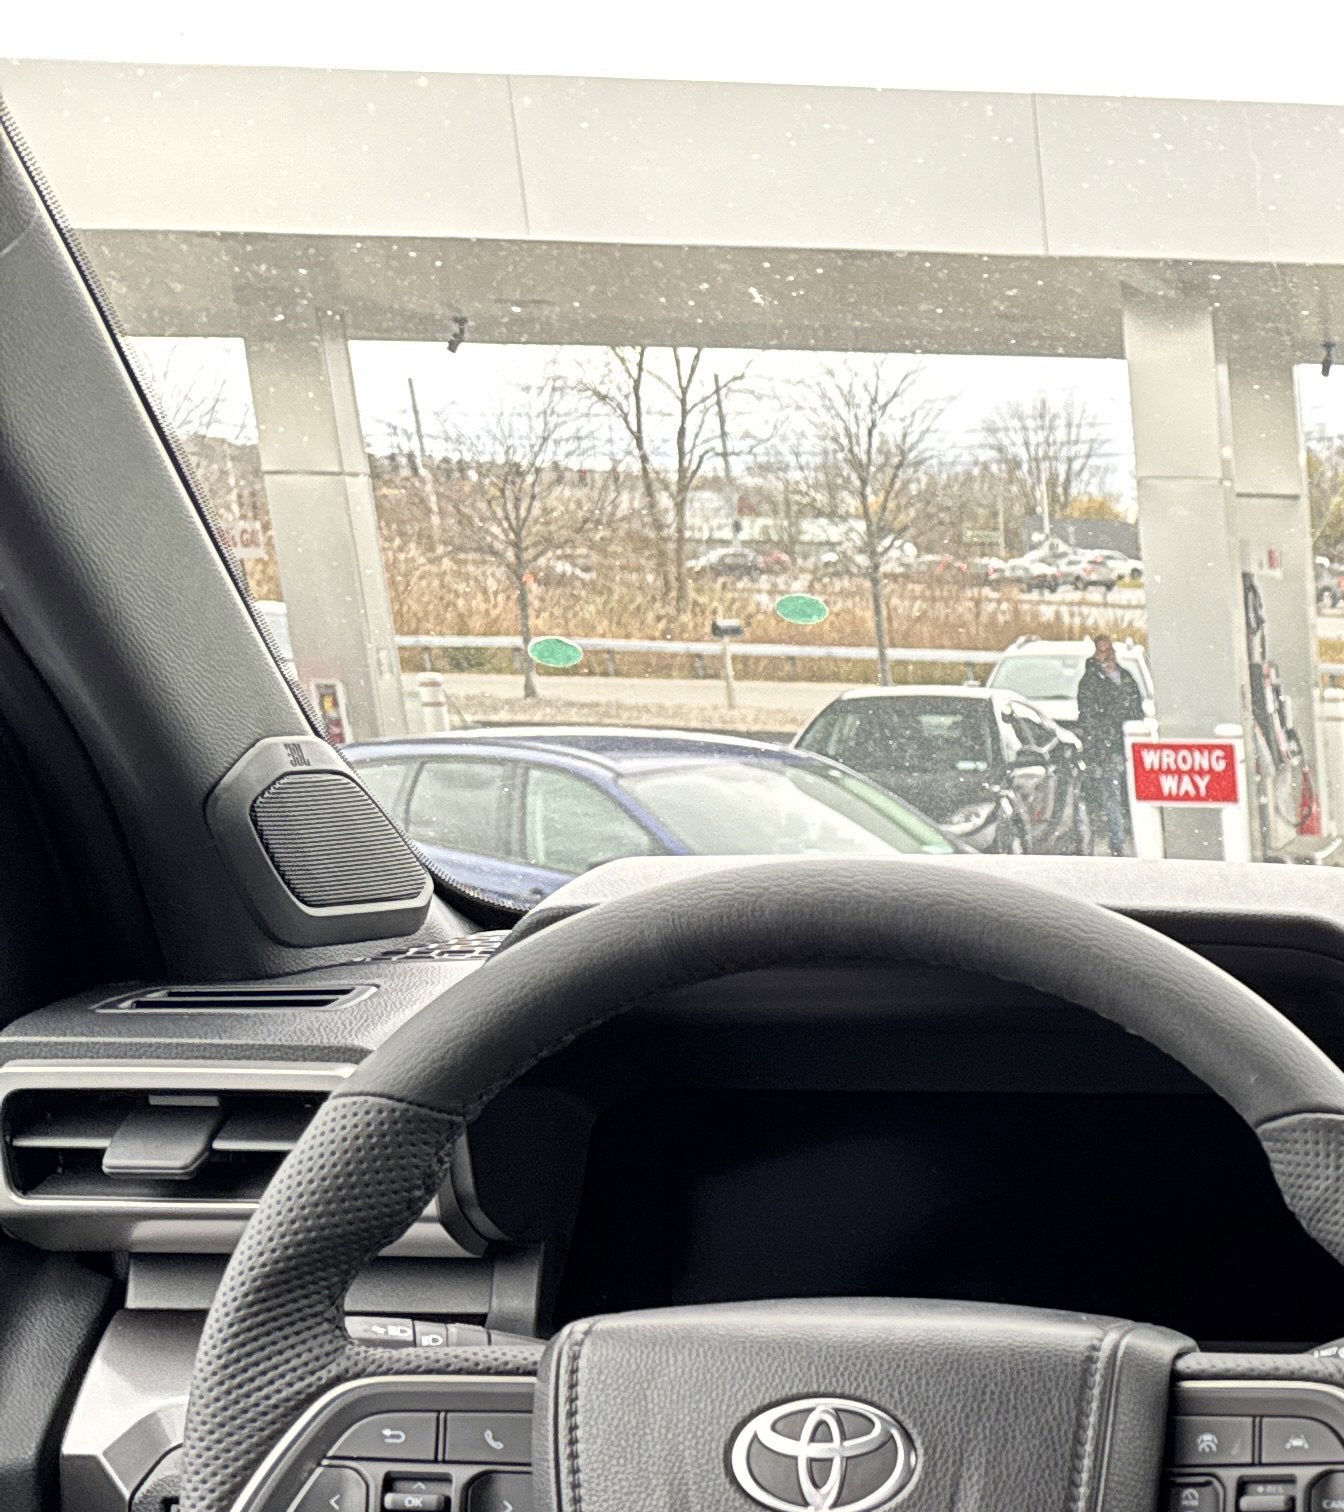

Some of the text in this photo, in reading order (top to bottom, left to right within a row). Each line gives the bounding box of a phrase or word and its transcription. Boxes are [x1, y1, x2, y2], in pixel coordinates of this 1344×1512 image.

[1141, 748, 1226, 772] WRONG
[1159, 773, 1211, 798] WAY
[404, 1496, 423, 1508] OK
